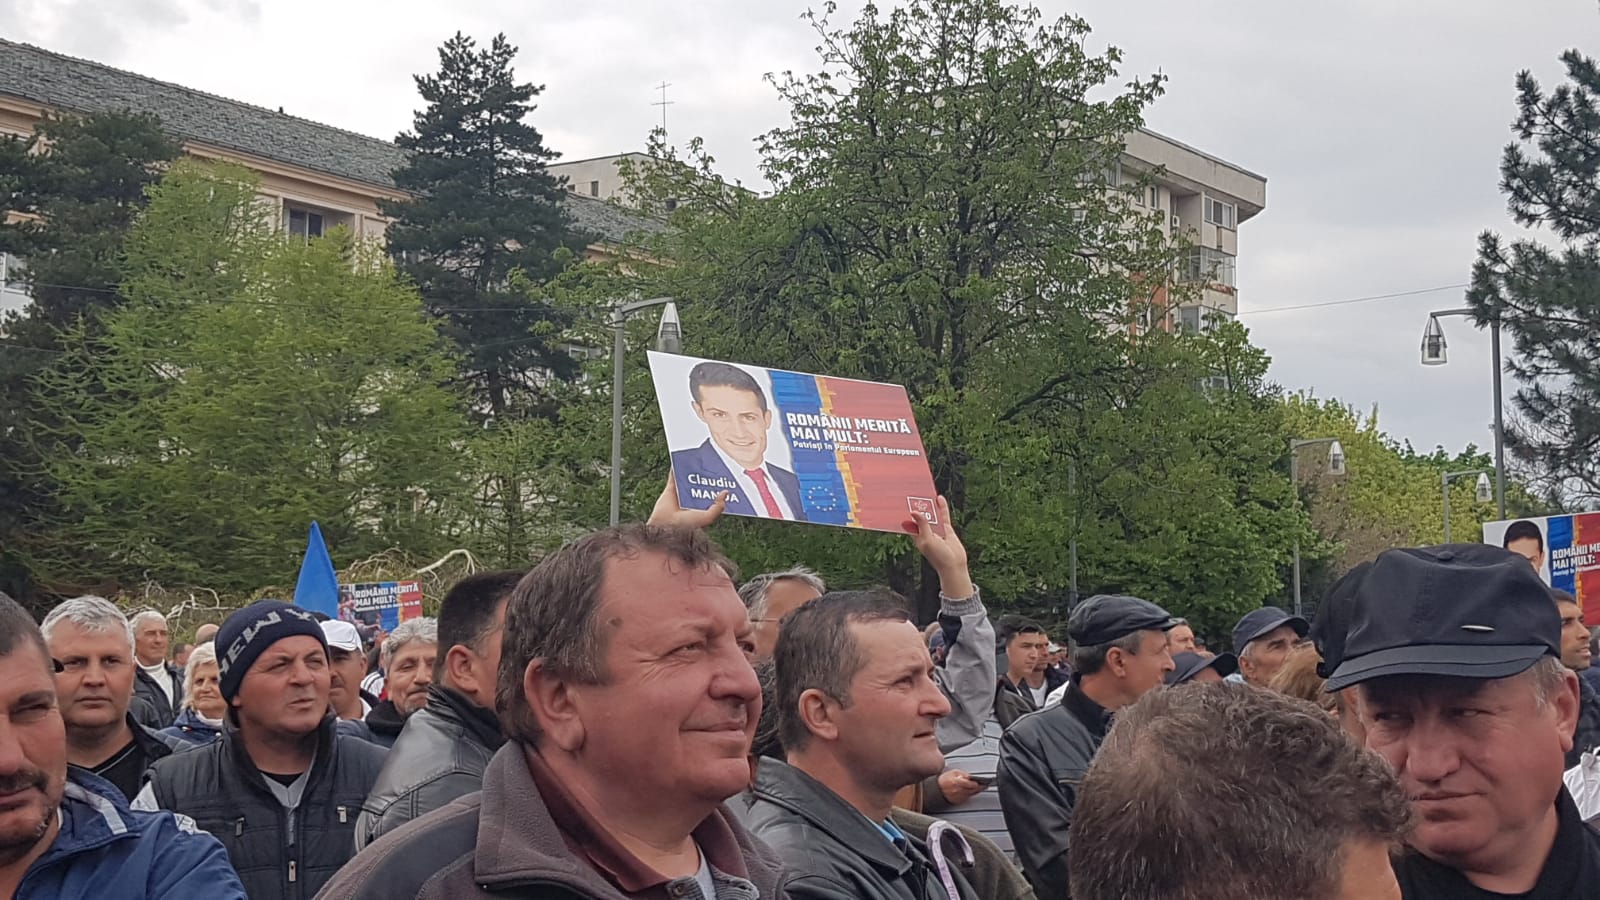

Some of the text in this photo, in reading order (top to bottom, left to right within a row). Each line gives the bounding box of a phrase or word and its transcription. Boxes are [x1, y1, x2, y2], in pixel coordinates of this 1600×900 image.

[786, 412, 911, 434] ROMÂNII MERITĂ
[789, 426, 870, 444] MAI MULT:
[687, 473, 737, 489] Claudiu
[1553, 554, 1596, 570] MAI MULT:
[354, 597, 371, 607] MAI
